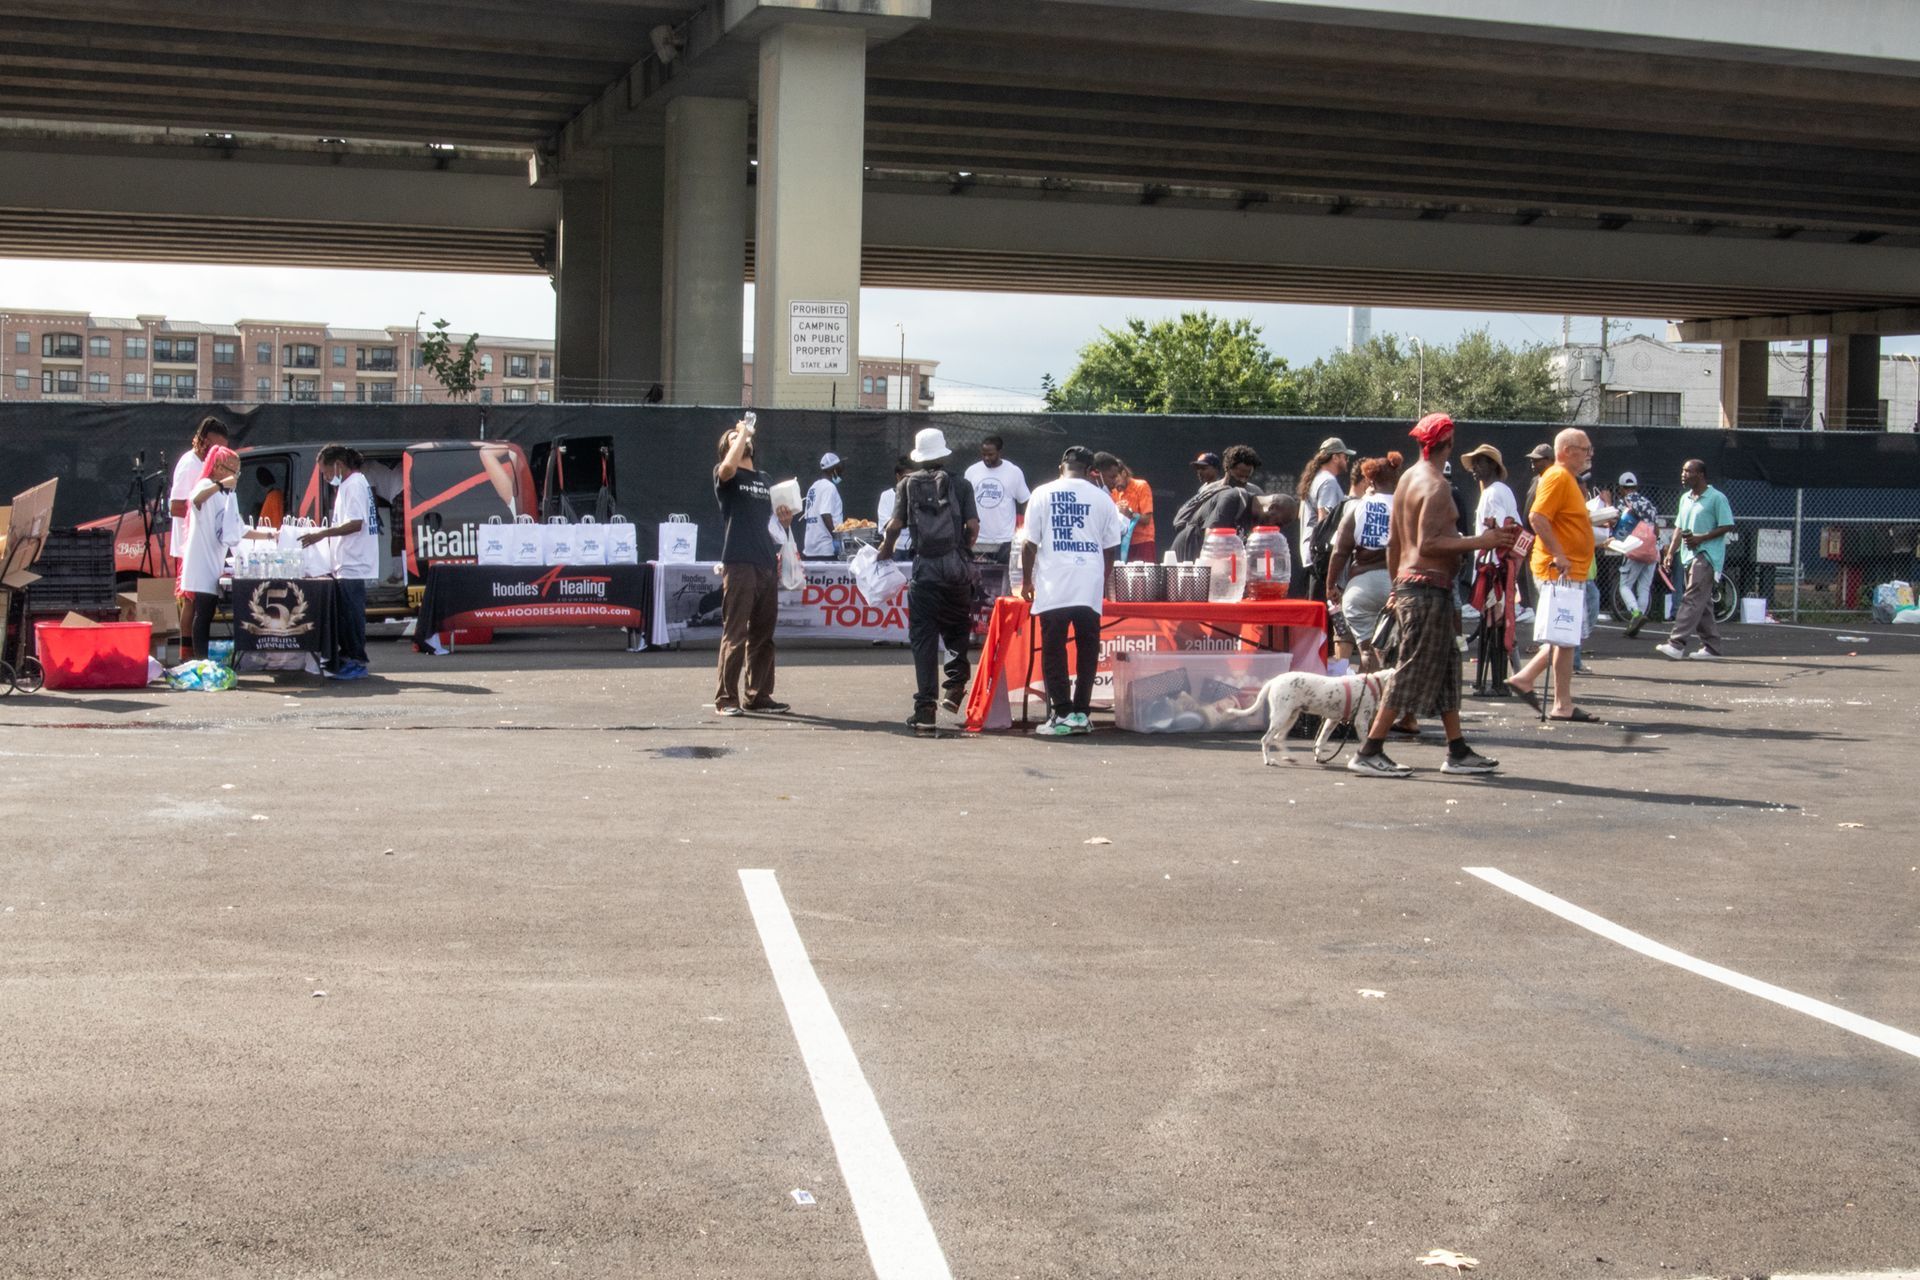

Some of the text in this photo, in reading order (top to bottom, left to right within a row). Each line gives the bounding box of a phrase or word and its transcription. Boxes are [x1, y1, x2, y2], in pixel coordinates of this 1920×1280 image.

[793, 305, 845, 314] PROHIBITED
[799, 322, 840, 331] CAMPING
[794, 334, 844, 343] ON PUBLIC
[796, 346, 842, 355] PROPERTY
[1050, 492, 1076, 502] THIS
[1051, 503, 1091, 515] TSHIRT
[1052, 516, 1084, 528] HELPS
[1052, 528, 1072, 540] THE
[418, 523, 476, 557] Heali
[682, 574, 706, 583] Hoodies
[806, 575, 856, 586] Help the
[493, 582, 539, 596] Hoodies
[560, 579, 605, 597] Healing
[689, 584, 713, 593] Healing
[266, 588, 290, 628] 5
[474, 606, 631, 617] www.HOODIES4HEALING.com
